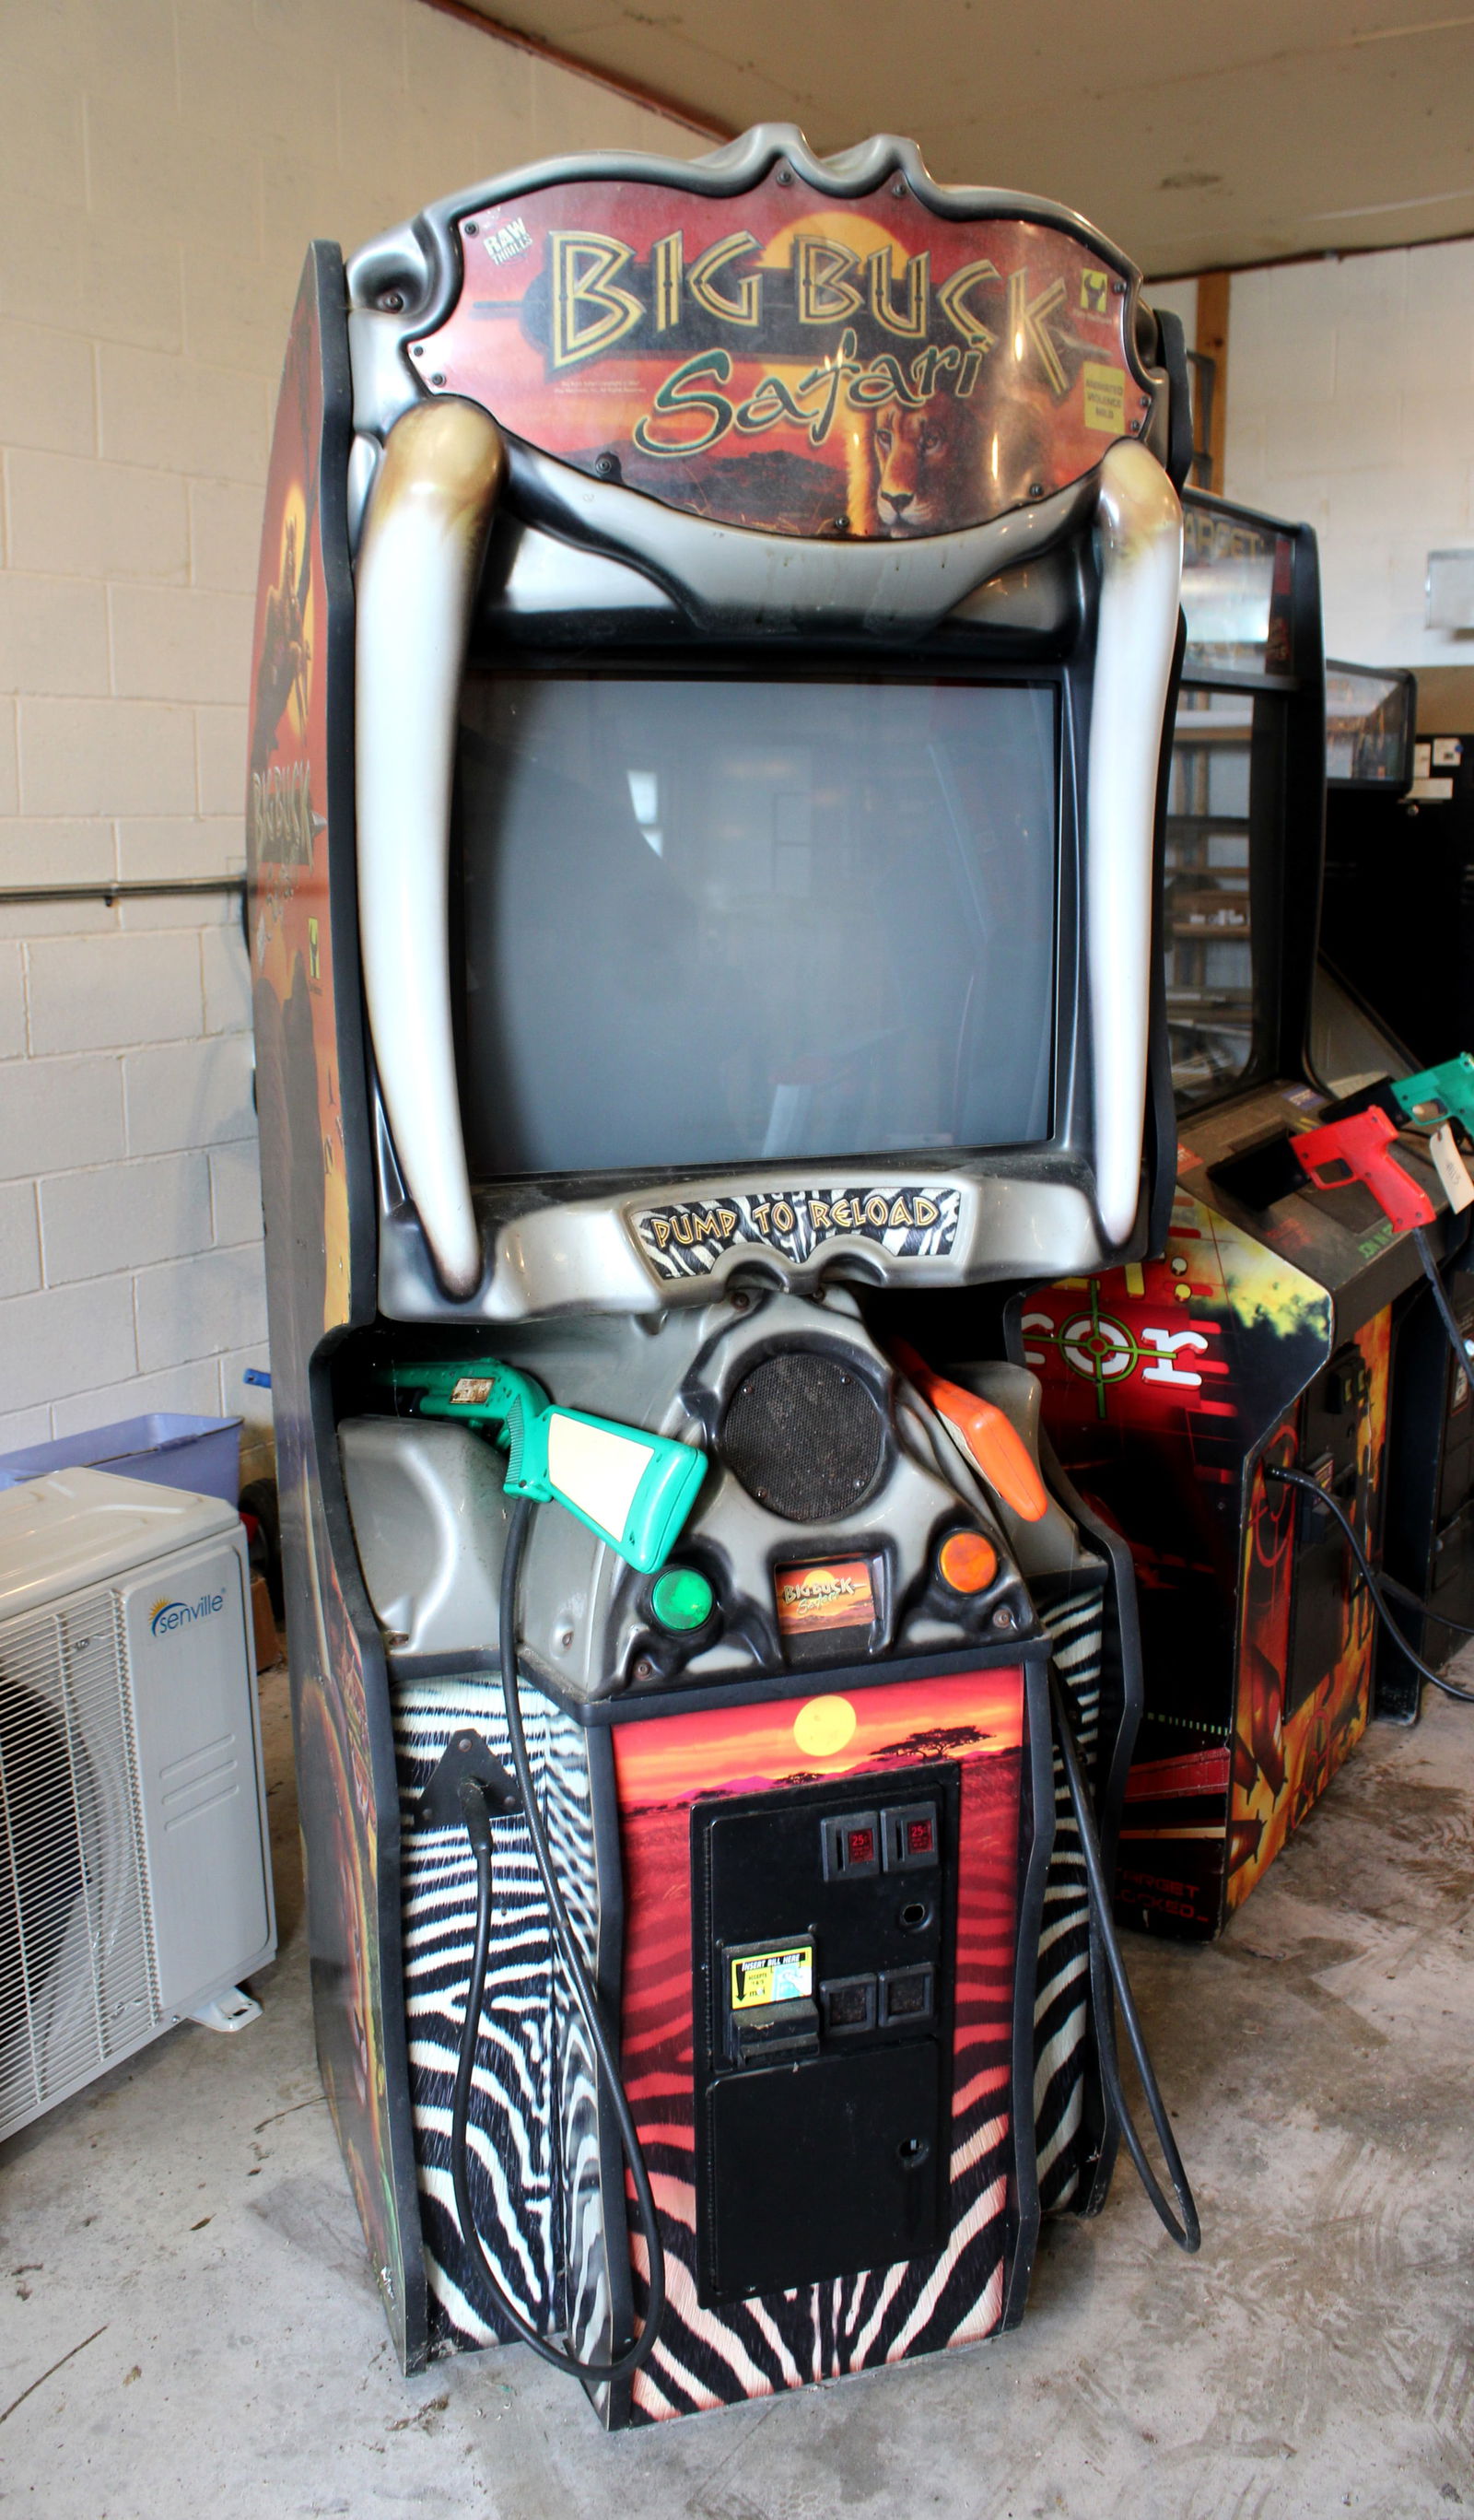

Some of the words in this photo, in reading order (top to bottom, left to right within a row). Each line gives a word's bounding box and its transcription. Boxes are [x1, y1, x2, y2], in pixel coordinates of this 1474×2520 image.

[484, 217, 527, 254] RAW
[548, 229, 766, 369] BIG
[793, 233, 1069, 396] BUCK
[634, 326, 986, 459] Safari
[649, 1207, 737, 1249] PUMP
[752, 1201, 796, 1235] TO
[807, 1196, 940, 1230] RELOAD
[784, 1584, 811, 1604] BIG
[812, 1577, 855, 1596] BUCK
[159, 1593, 224, 1635] senville
[742, 1959, 766, 1972] INSERT
[766, 1957, 781, 1968] BILL
[782, 1952, 801, 1964] HERE
